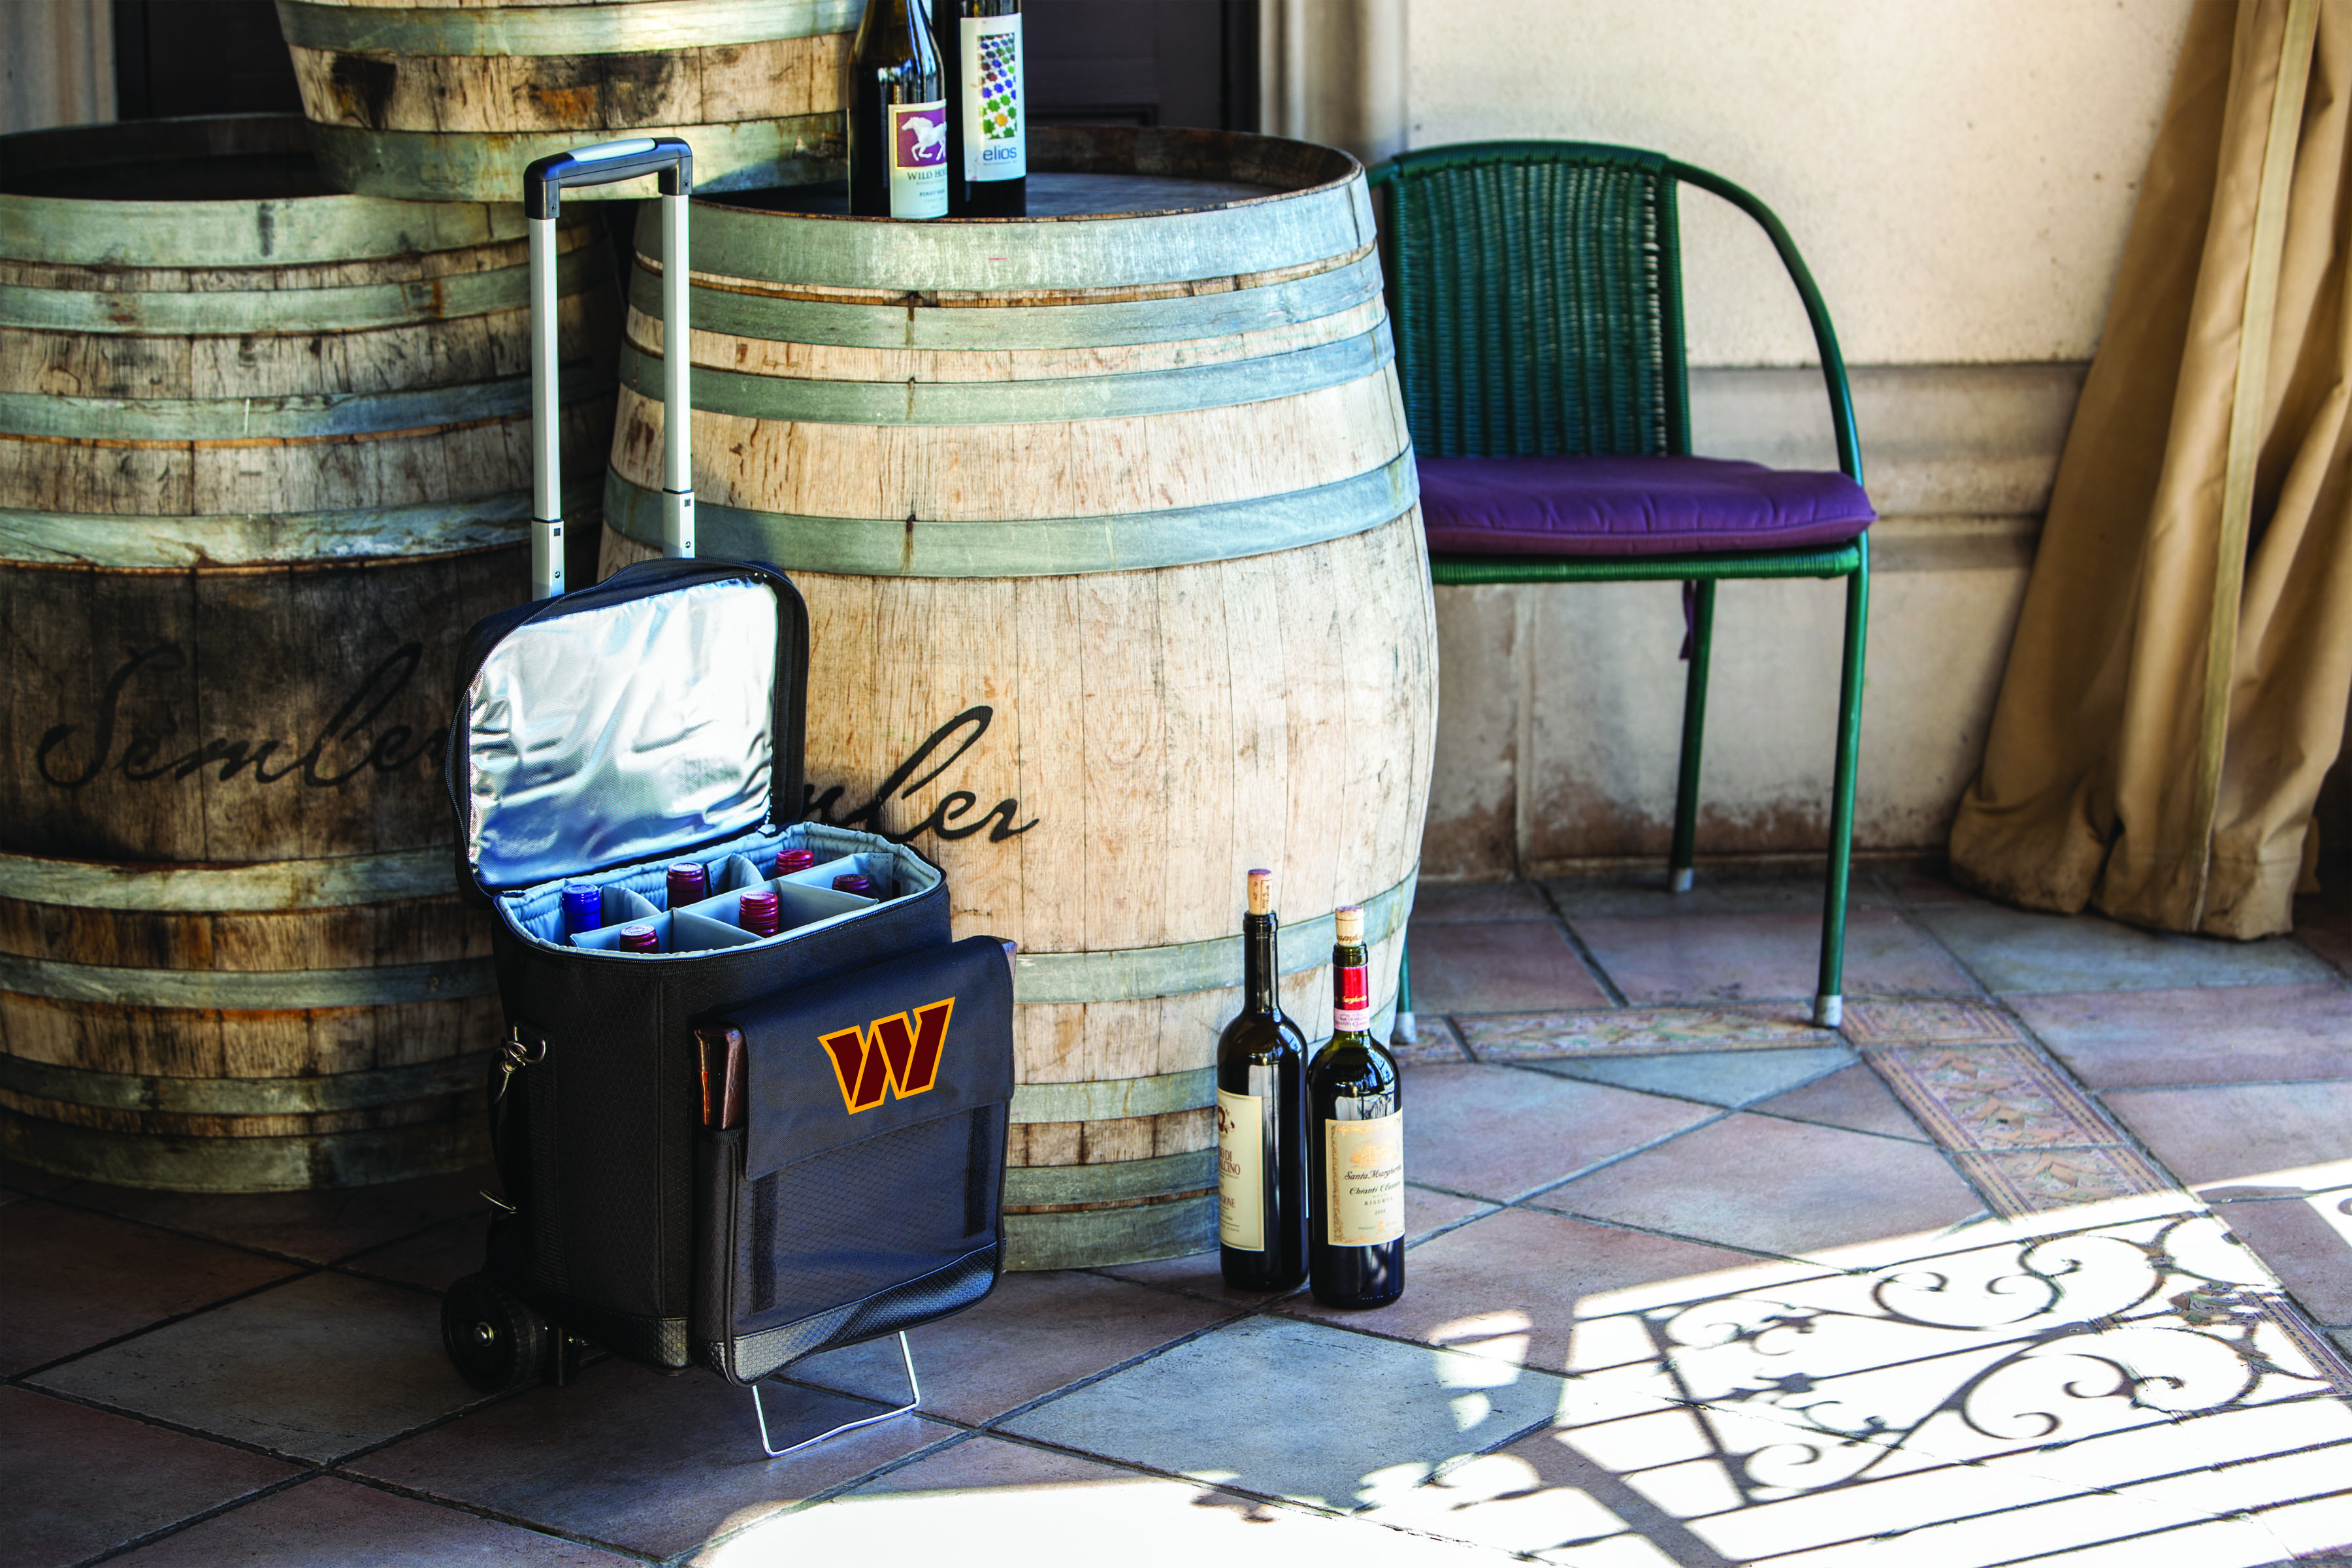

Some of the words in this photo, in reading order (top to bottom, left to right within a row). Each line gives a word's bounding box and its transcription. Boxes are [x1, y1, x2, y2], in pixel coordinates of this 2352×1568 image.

[983, 145, 1017, 161] elios
[907, 171, 933, 180] WILD
[817, 996, 956, 1115] W
[1345, 1171, 1369, 1181] Santa
[1349, 1186, 1379, 1196] Chianti
[1364, 1196, 1393, 1206] RISERVA
